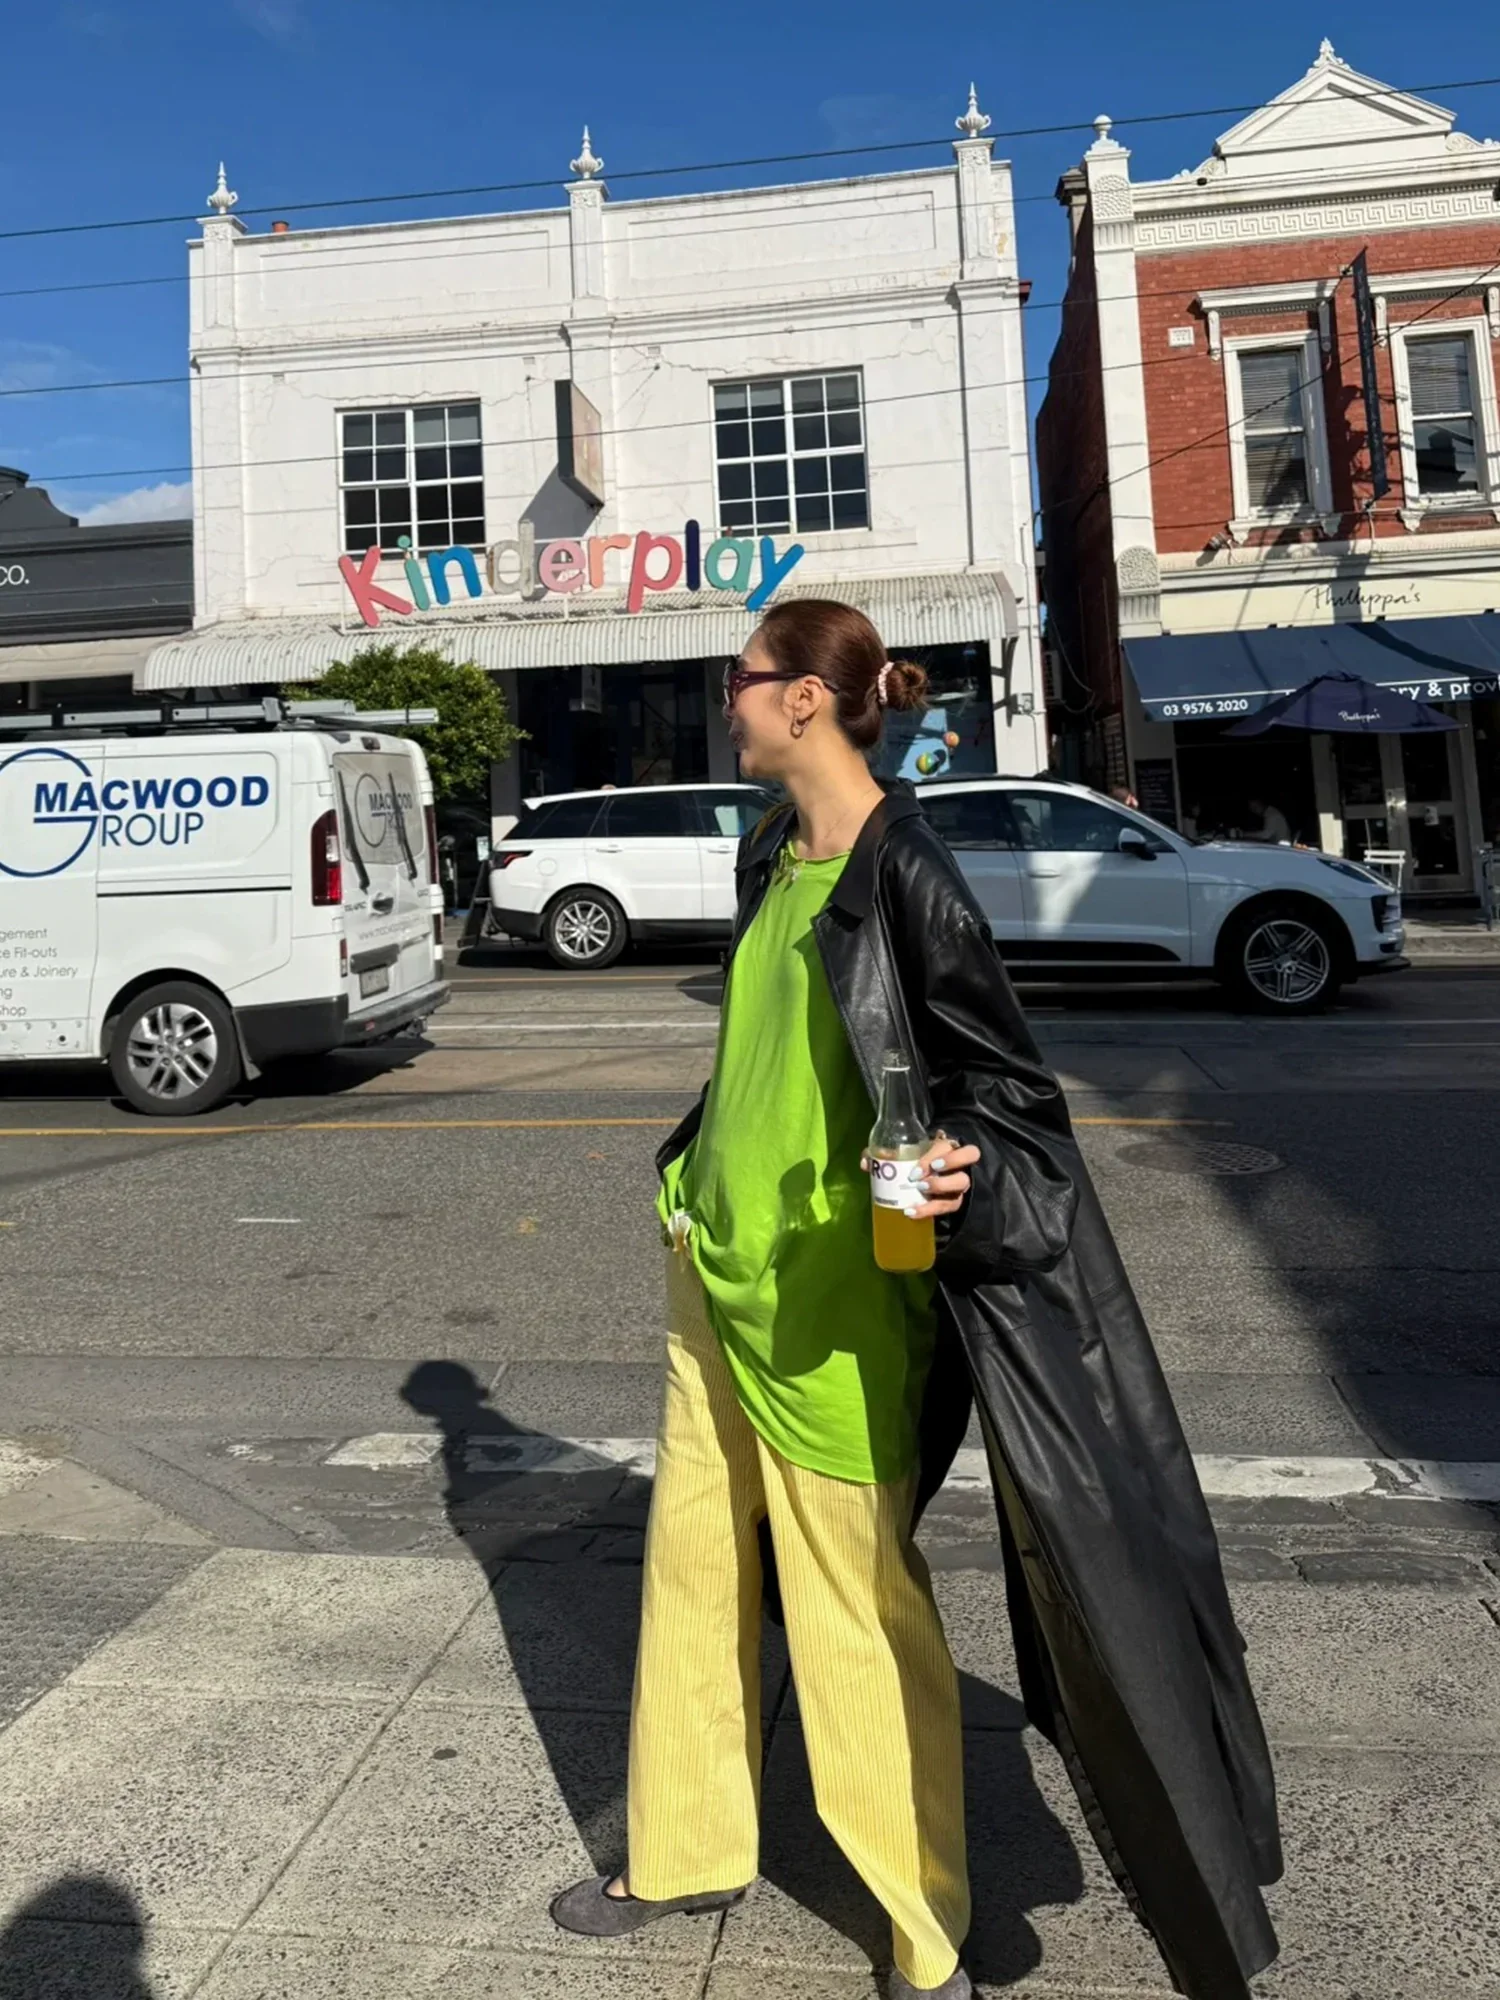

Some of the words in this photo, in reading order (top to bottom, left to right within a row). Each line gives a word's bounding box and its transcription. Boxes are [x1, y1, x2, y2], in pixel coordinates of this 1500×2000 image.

[1390, 681, 1420, 700] ry
[1427, 681, 1443, 697] &
[1450, 680, 1500, 700] prov
[1163, 704, 1179, 716] 03
[1182, 702, 1213, 715] 9576
[1216, 699, 1248, 712] 2020
[34, 776, 269, 813] MACWOOD
[14, 946, 57, 958] Fit-outs
[20, 966, 29, 977] &
[34, 964, 78, 978] Joinery
